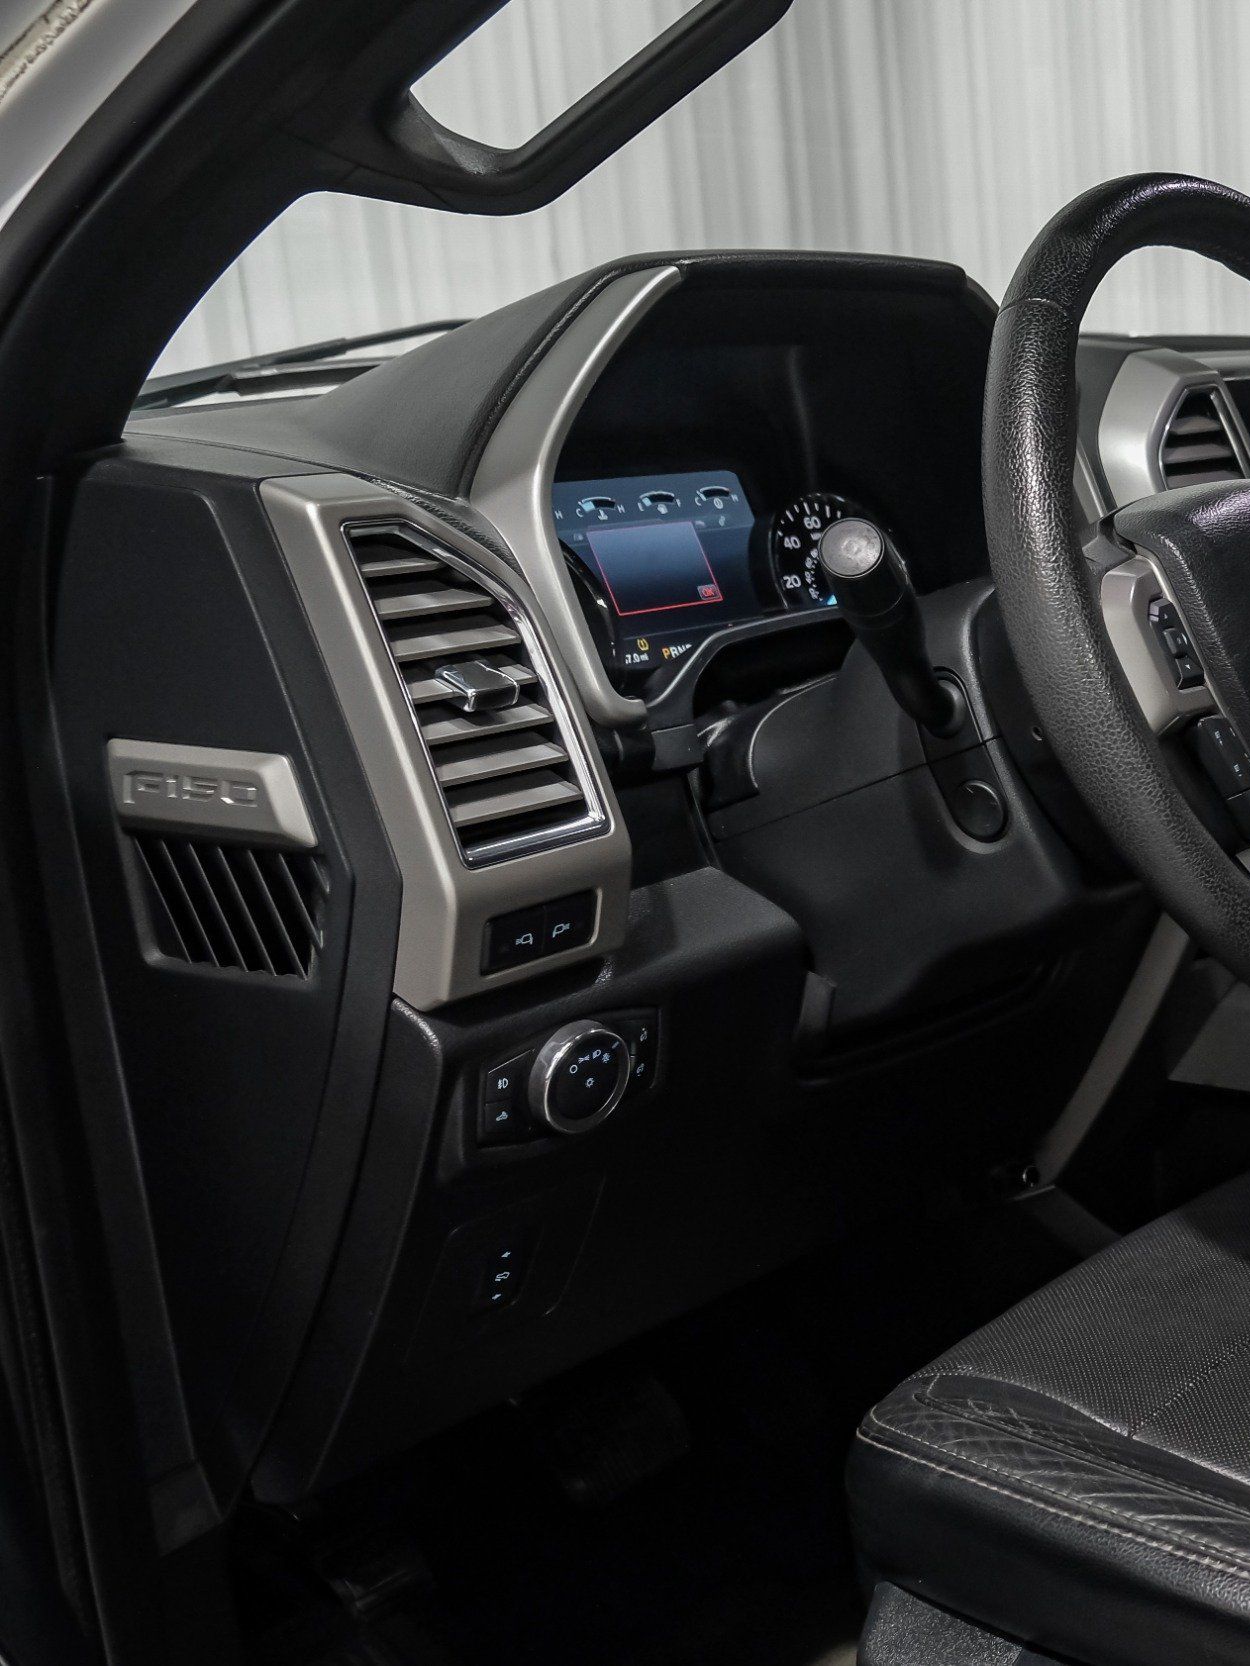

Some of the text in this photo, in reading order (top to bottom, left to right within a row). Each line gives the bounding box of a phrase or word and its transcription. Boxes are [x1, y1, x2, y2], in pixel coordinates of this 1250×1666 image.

[803, 516, 821, 530] 60
[783, 535, 801, 550] 40
[782, 574, 801, 589] 20
